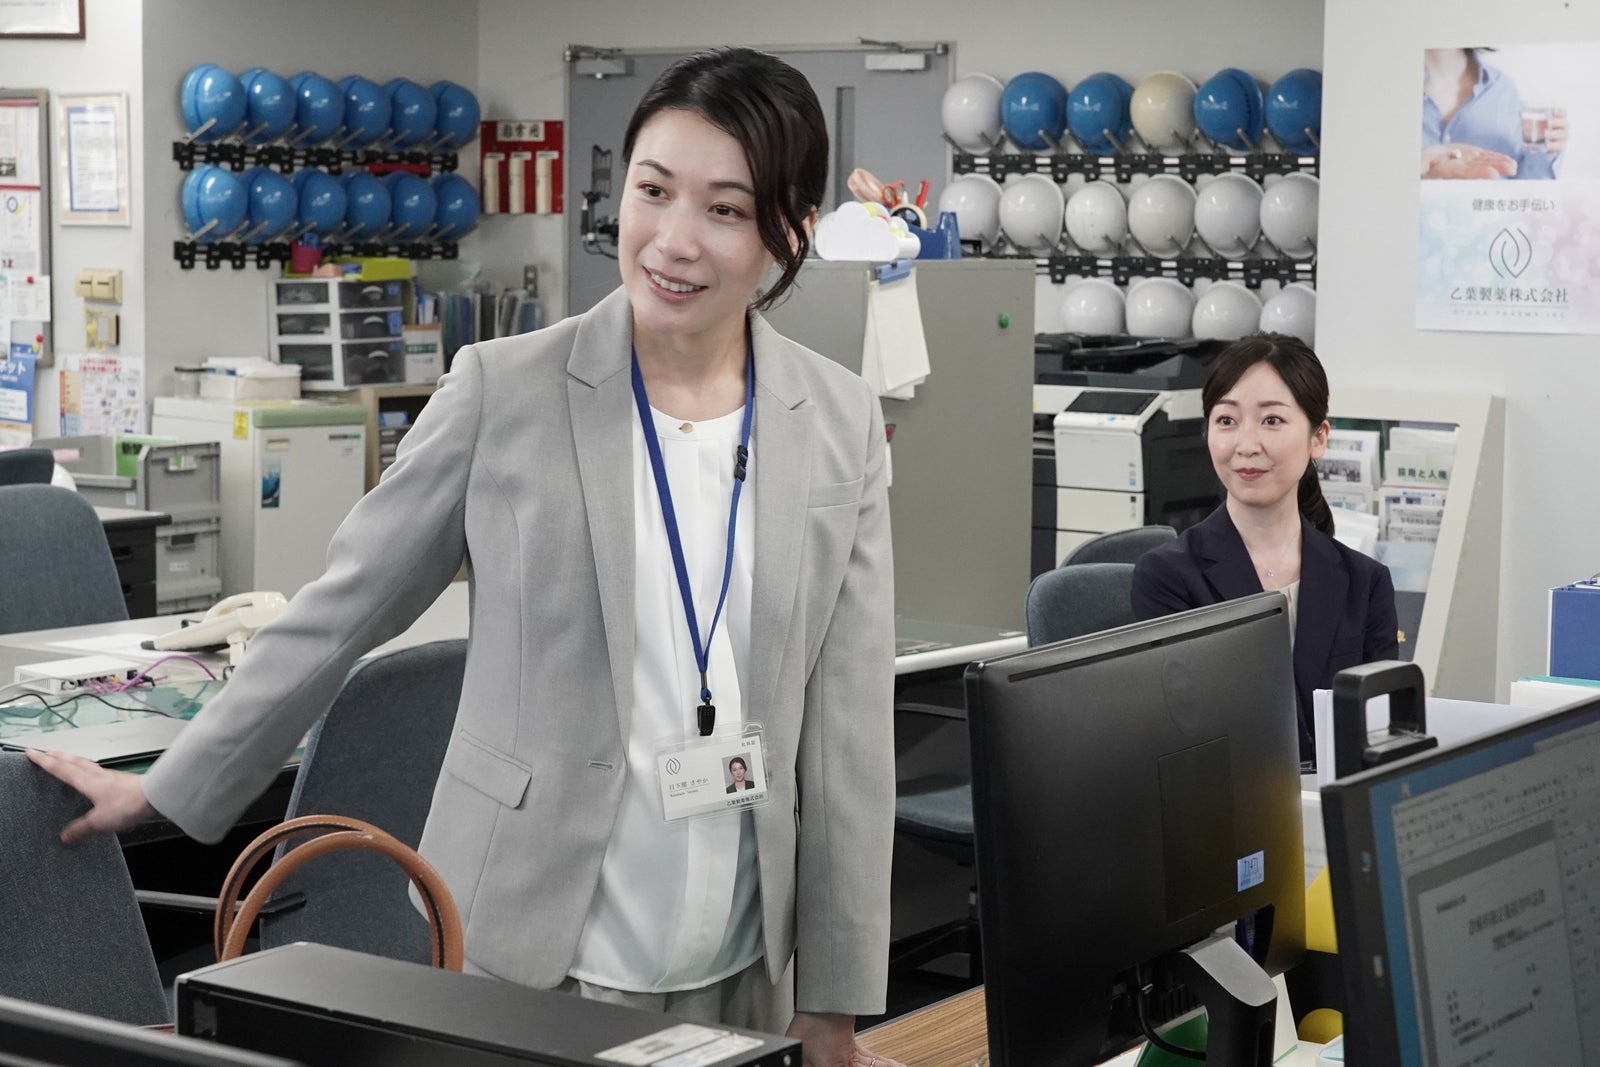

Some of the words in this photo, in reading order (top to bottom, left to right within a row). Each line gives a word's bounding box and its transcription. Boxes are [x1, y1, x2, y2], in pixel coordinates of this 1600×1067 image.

[1472, 197, 1556, 212] 健康をお手伝い
[1450, 287, 1568, 303] 乙葉製薬株式会社
